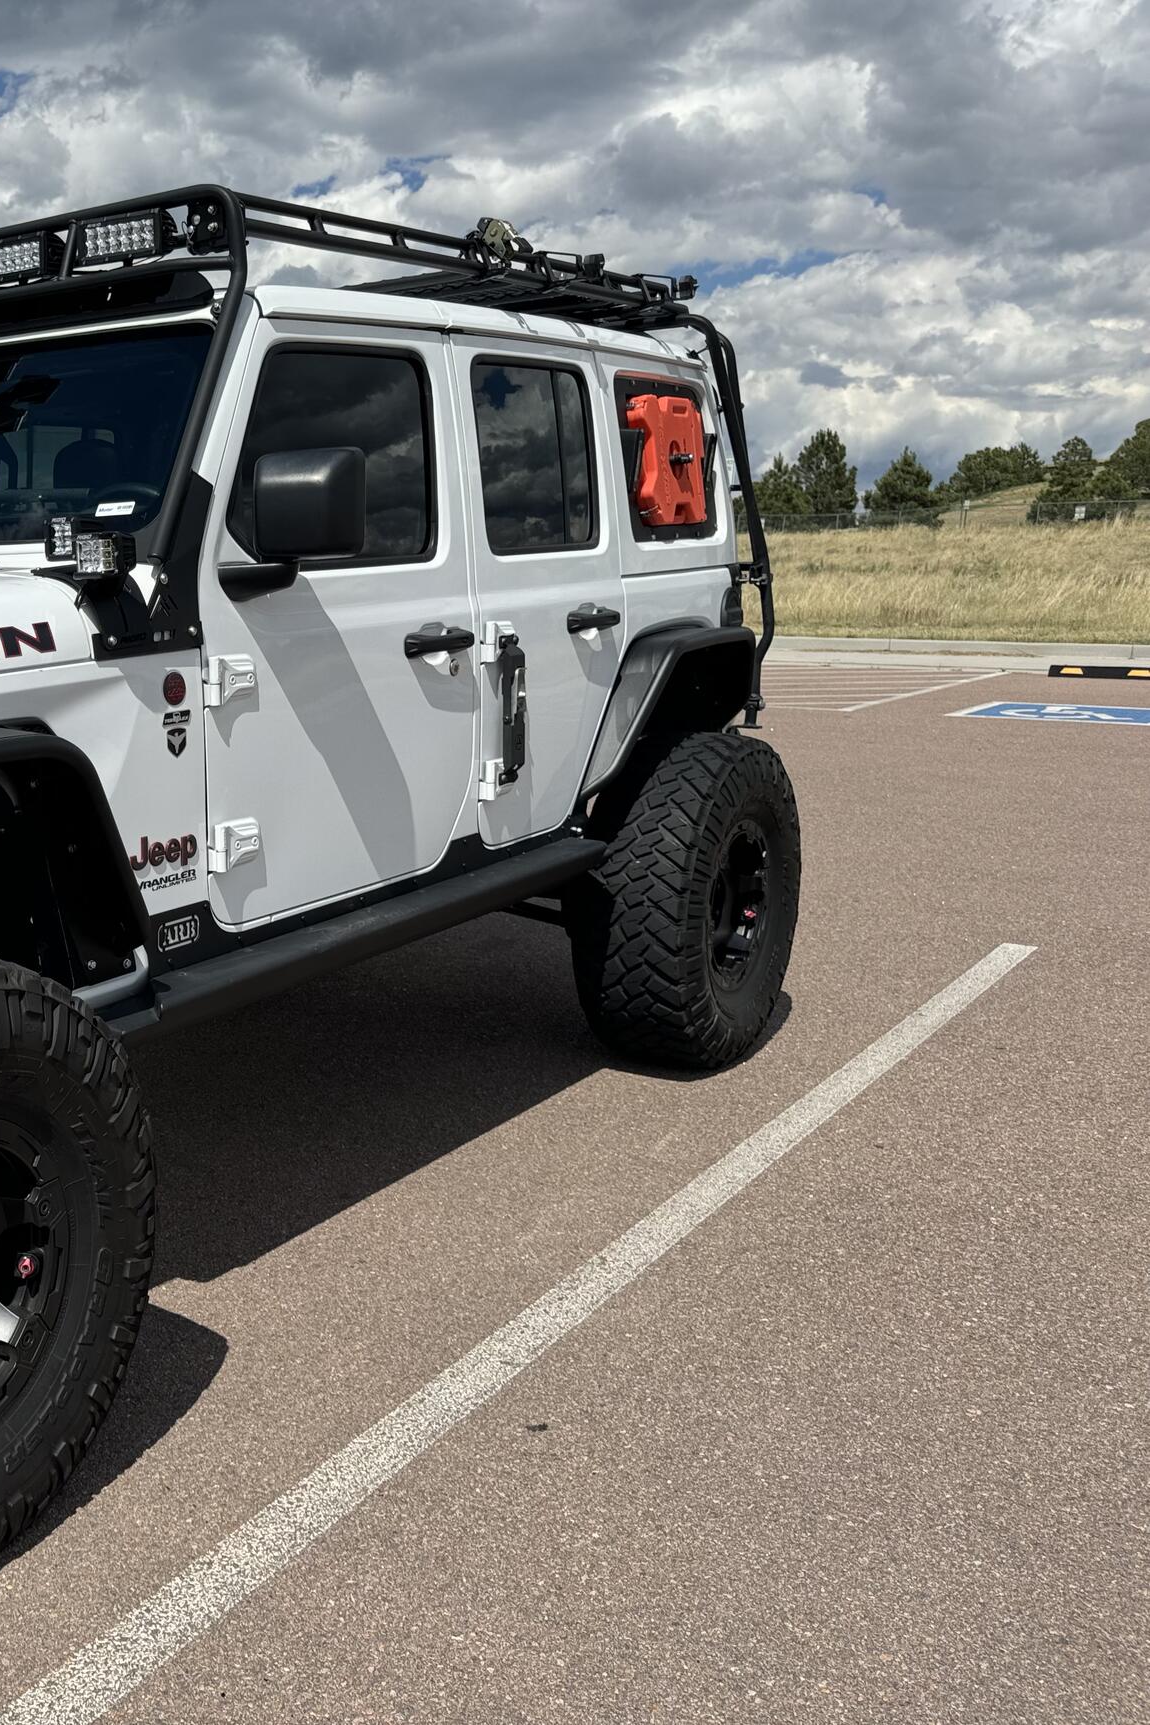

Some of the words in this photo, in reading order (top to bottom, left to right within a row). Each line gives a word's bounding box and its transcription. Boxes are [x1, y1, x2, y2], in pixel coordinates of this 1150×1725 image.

[130, 834, 198, 871] Jeep
[152, 877, 197, 892] UNLIMITED
[162, 921, 196, 946] ARB
